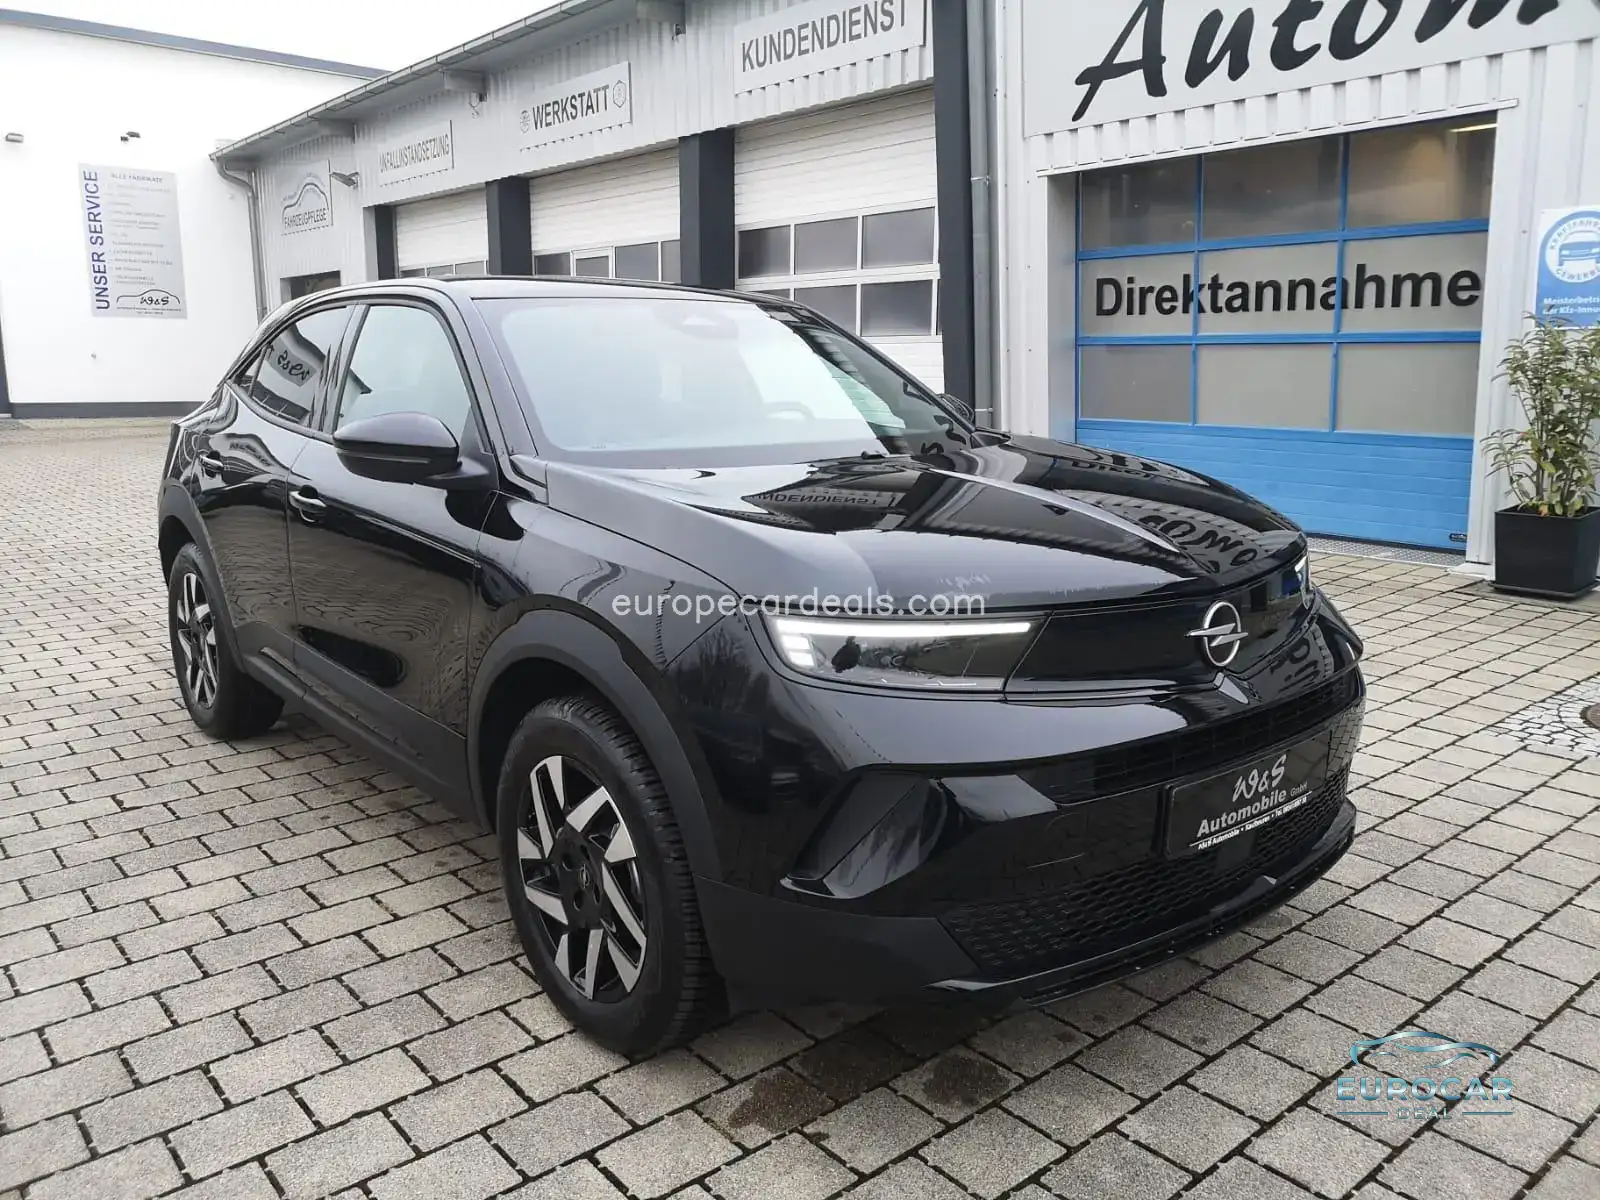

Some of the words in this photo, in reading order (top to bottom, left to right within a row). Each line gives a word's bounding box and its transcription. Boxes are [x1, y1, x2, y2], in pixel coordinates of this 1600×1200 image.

[742, 0, 905, 72] KUNDENDIENST
[532, 84, 609, 130] WERKSTATT
[83, 170, 104, 246] SERVICE
[91, 251, 110, 310] UNSER
[1096, 263, 1481, 316] Direktannahme
[1197, 790, 1287, 838] Automobile
